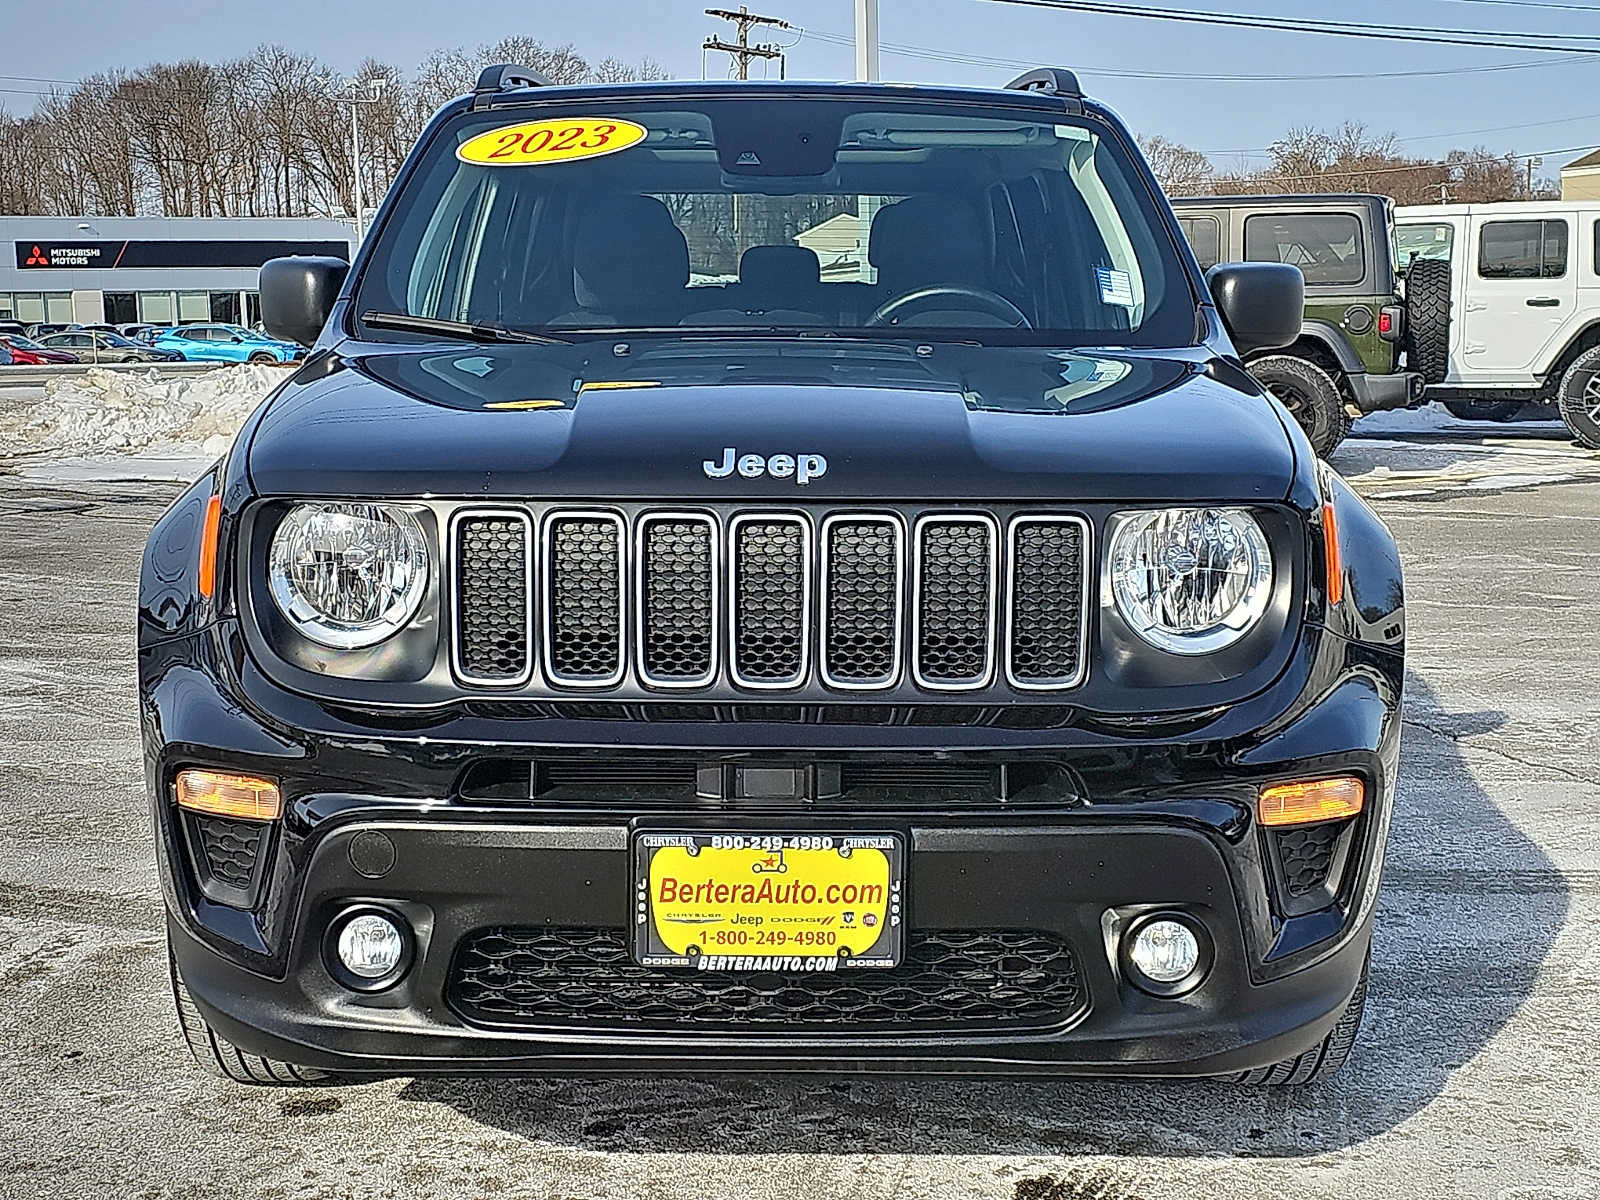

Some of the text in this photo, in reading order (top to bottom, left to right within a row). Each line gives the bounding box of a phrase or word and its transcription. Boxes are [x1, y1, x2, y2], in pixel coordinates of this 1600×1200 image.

[487, 124, 617, 159] 2023
[50, 248, 101, 257] MITSUBISHI
[51, 256, 89, 265] MOTORS
[702, 447, 828, 485] Jeep
[643, 836, 694, 848] CHRYSLER
[711, 835, 834, 851] 800-249-4980
[842, 838, 895, 850] CHRYSLER
[659, 877, 883, 904] BerteraAuto.com
[730, 913, 764, 927] Jeep
[699, 930, 837, 946] 1-800-249-4980
[697, 955, 839, 972] BERTERAAUTO.COM
